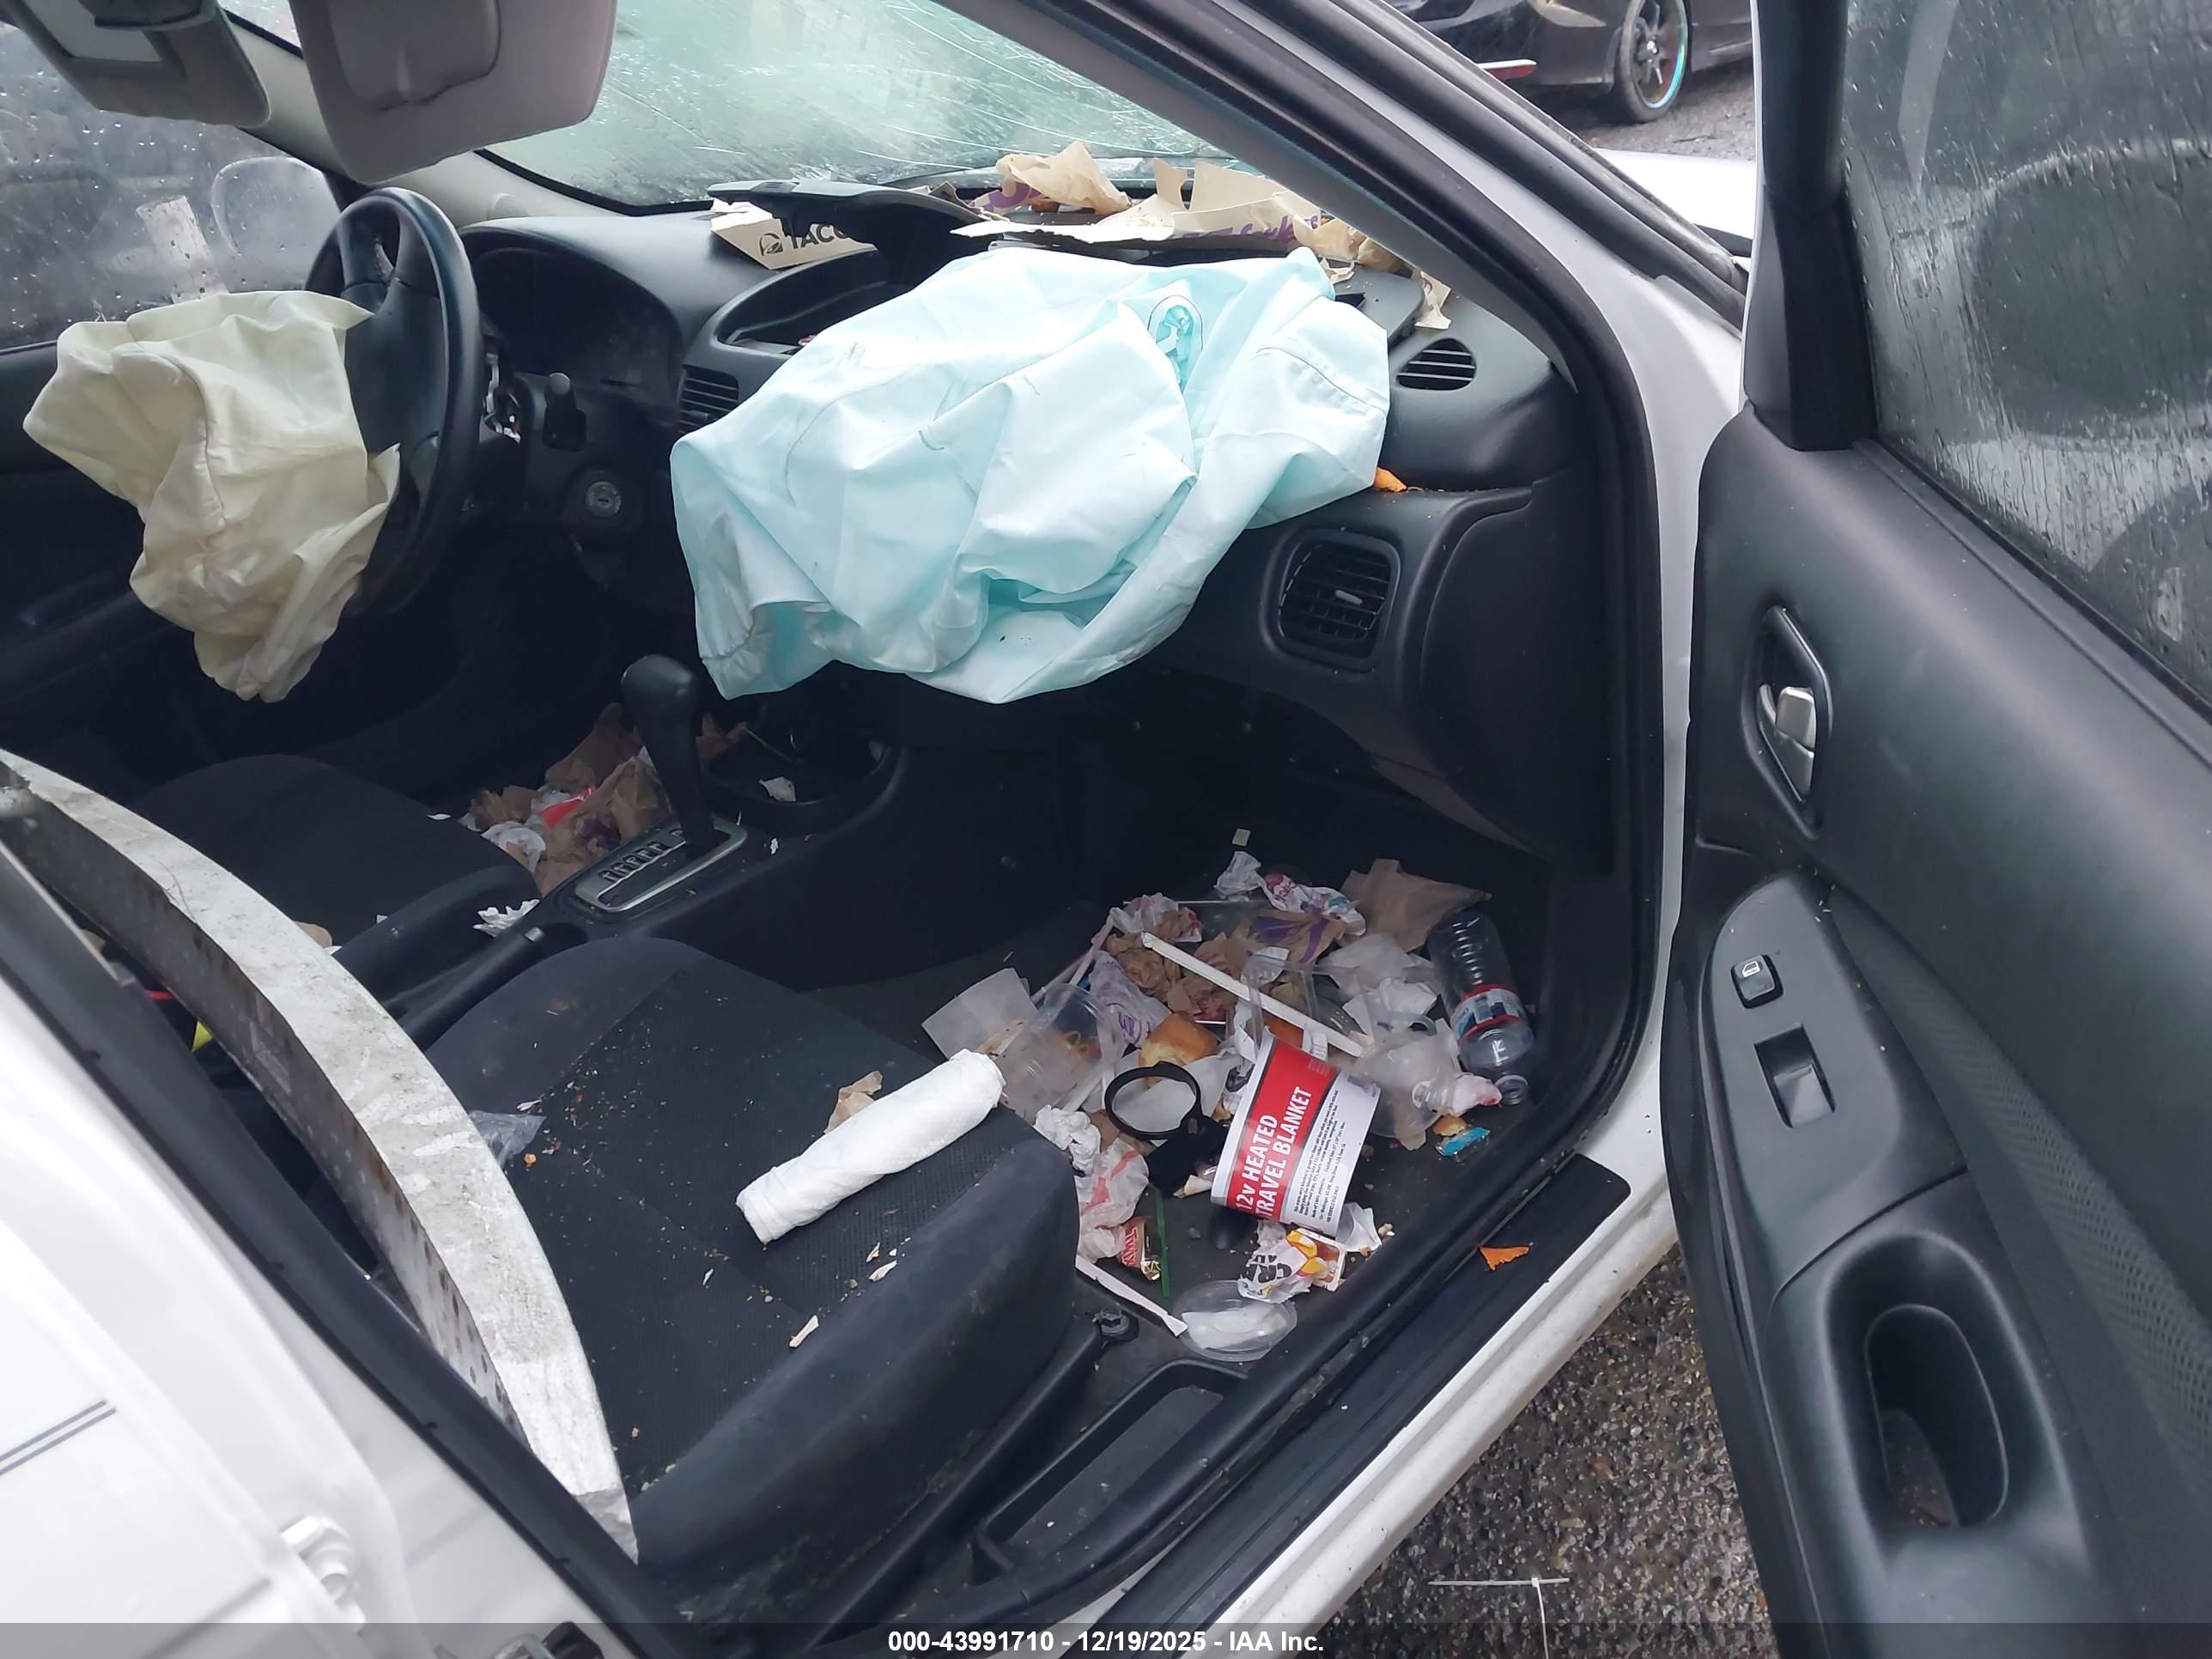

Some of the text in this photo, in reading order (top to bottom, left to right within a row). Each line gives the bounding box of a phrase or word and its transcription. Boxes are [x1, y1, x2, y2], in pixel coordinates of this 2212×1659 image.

[1236, 1114, 1279, 1210] 12v HEATED
[1255, 1159, 1287, 1219] TRAVEL
[1273, 1085, 1313, 1156] BLANKET
